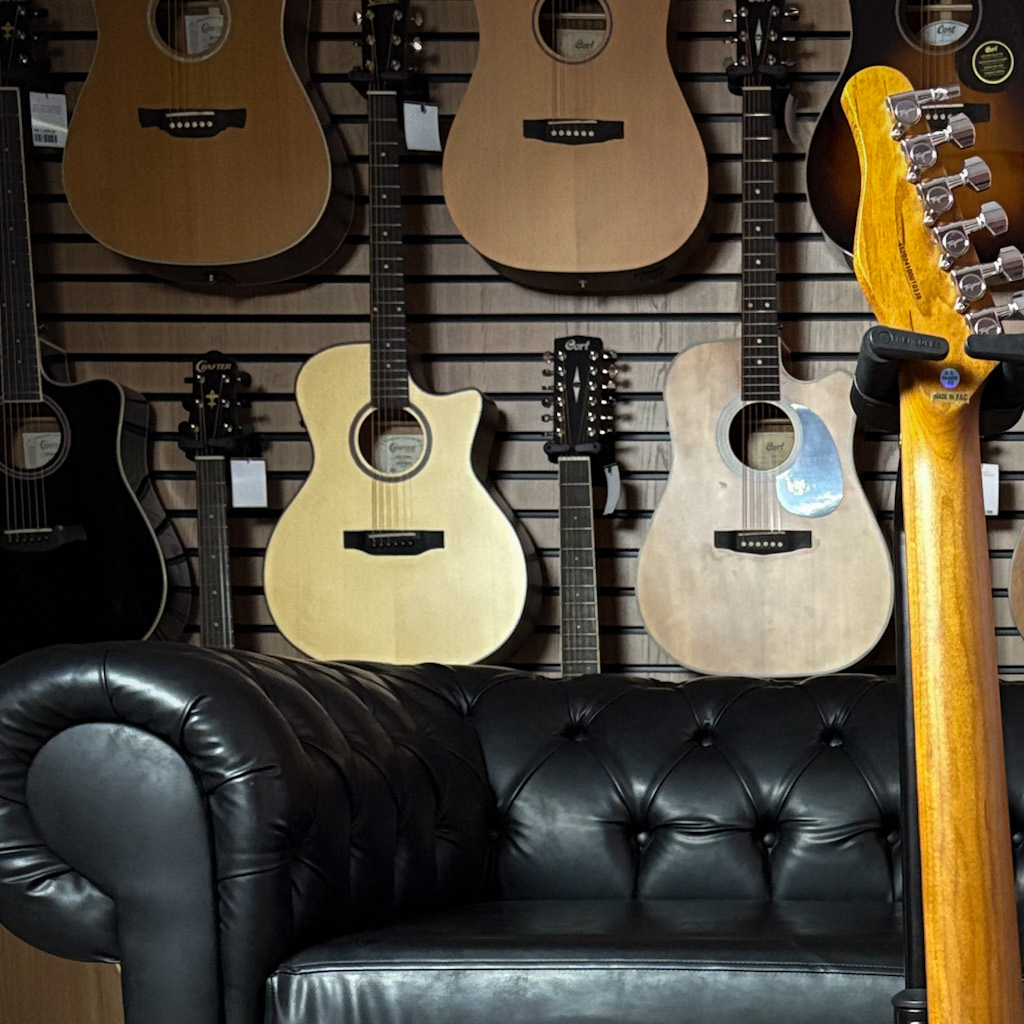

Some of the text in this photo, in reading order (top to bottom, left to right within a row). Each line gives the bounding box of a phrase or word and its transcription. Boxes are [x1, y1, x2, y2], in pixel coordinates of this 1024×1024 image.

[937, 25, 956, 34] Cort
[564, 339, 590, 351] Cort
[195, 360, 232, 373] CRAFTER
[765, 442, 785, 451] Cort
